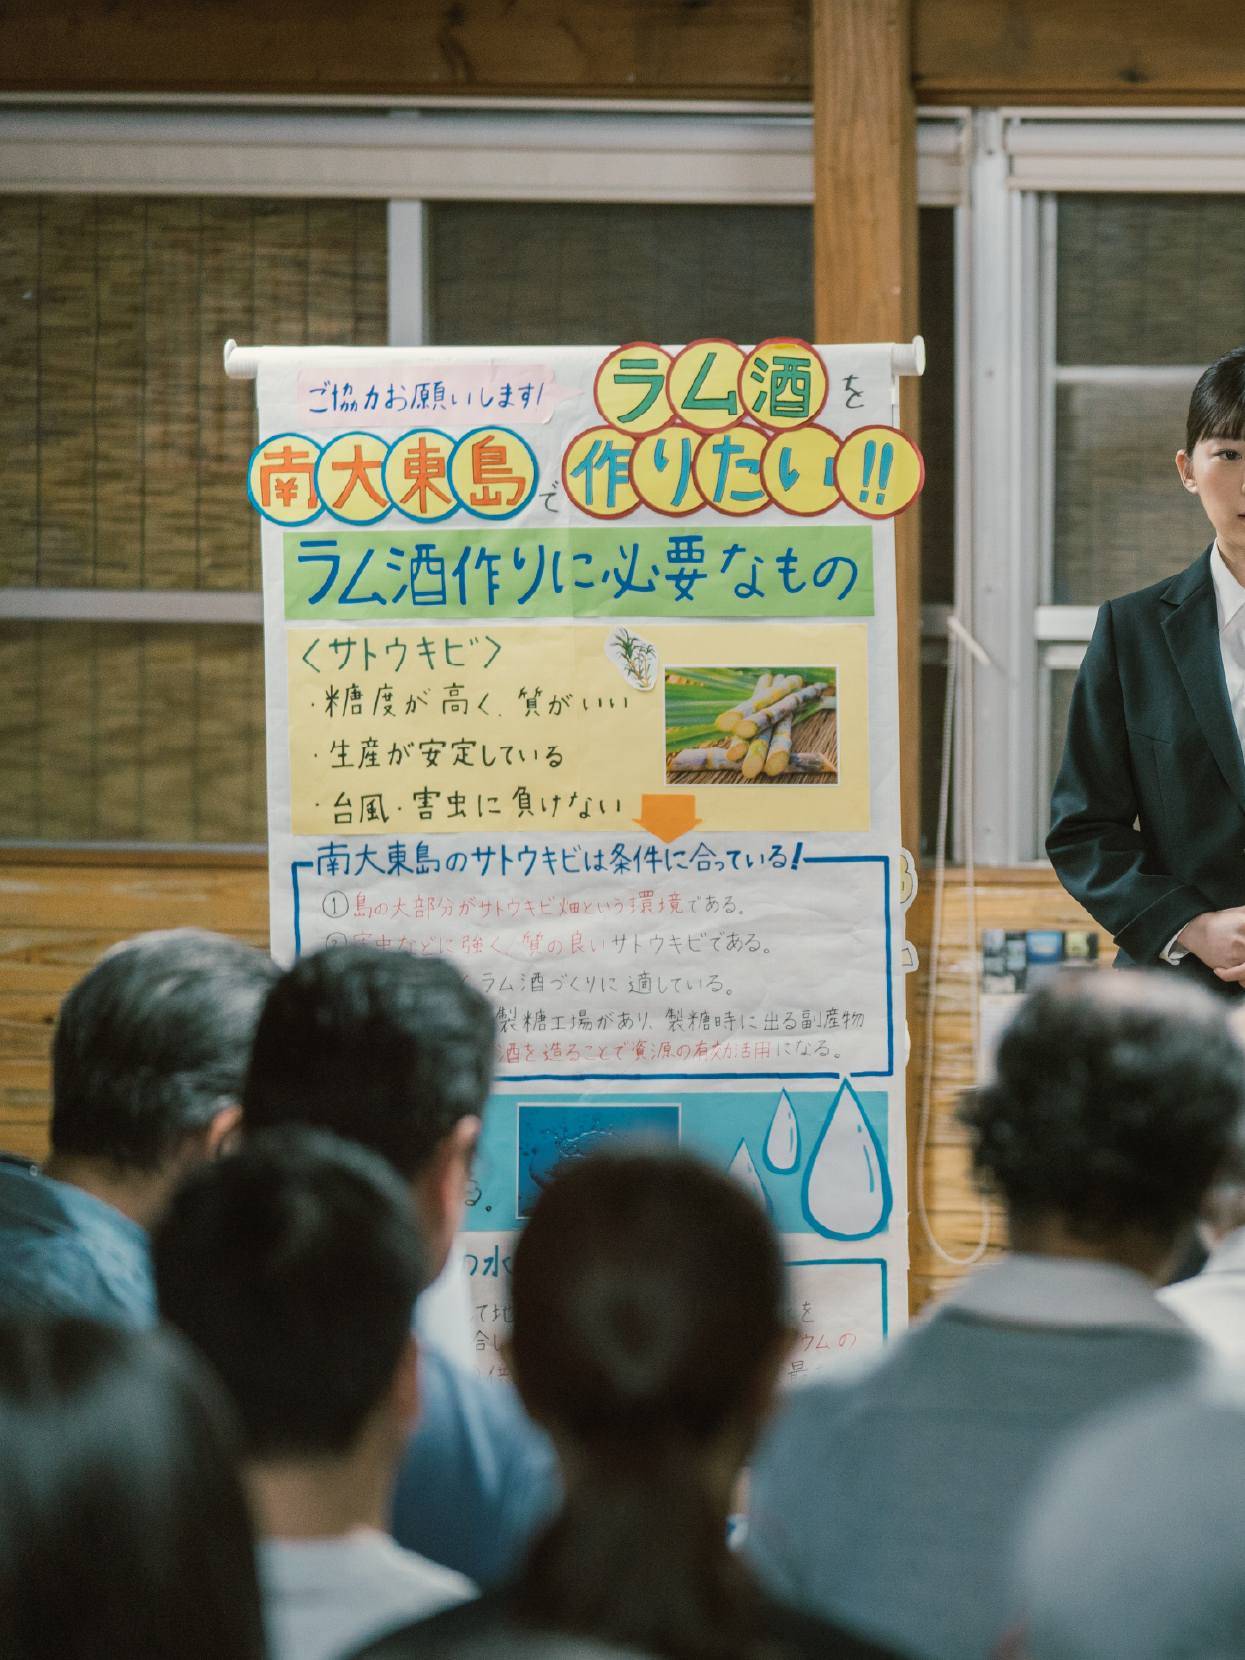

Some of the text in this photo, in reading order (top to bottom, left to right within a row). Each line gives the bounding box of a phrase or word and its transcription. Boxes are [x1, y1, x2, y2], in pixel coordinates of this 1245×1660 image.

[308, 380, 544, 413] ご協力お願いします!
[613, 351, 865, 423] ラム酒を
[297, 534, 858, 606] ラム酒作りに必要なもの
[317, 840, 804, 876] 南大東島のサトウキビは条件に合っている!
